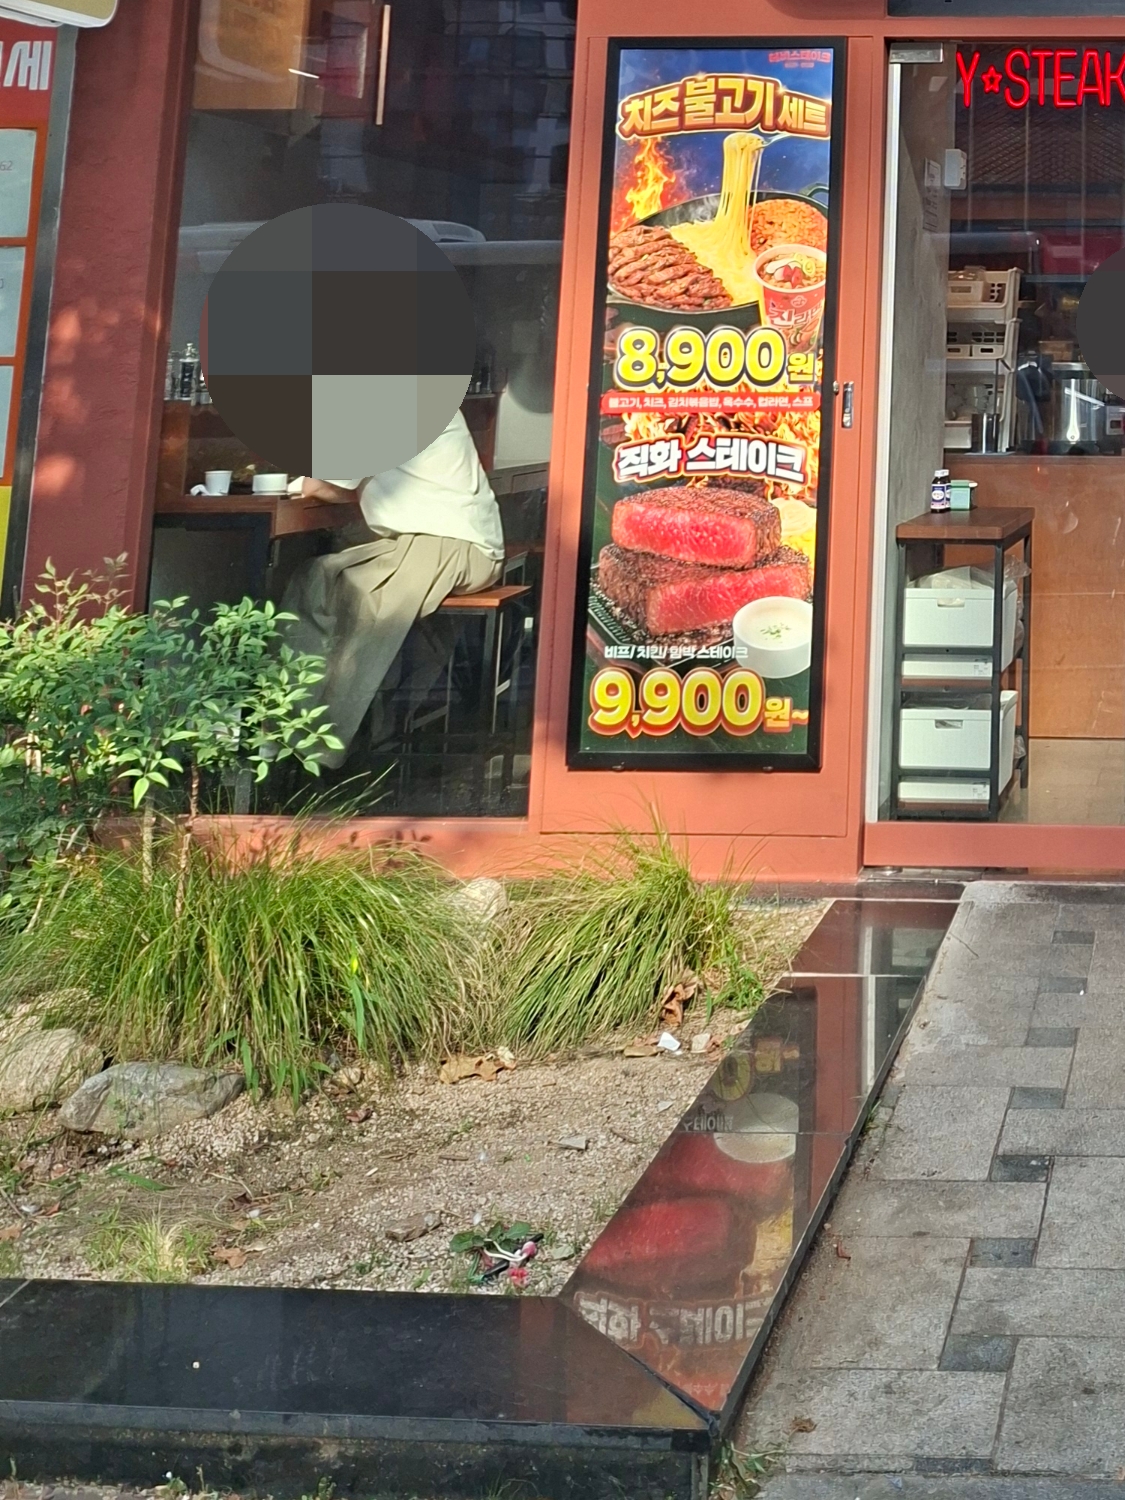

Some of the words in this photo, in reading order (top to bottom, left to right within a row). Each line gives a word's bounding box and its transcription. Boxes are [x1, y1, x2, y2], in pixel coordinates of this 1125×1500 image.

[0, 40, 53, 90] 세
[622, 87, 680, 132] 치즈
[684, 78, 775, 127] 불고기
[778, 94, 828, 133] 세트
[615, 327, 816, 386] 8,900원
[617, 437, 682, 479] 직화
[685, 437, 806, 483] 스테이크
[696, 645, 749, 660] 스테이크
